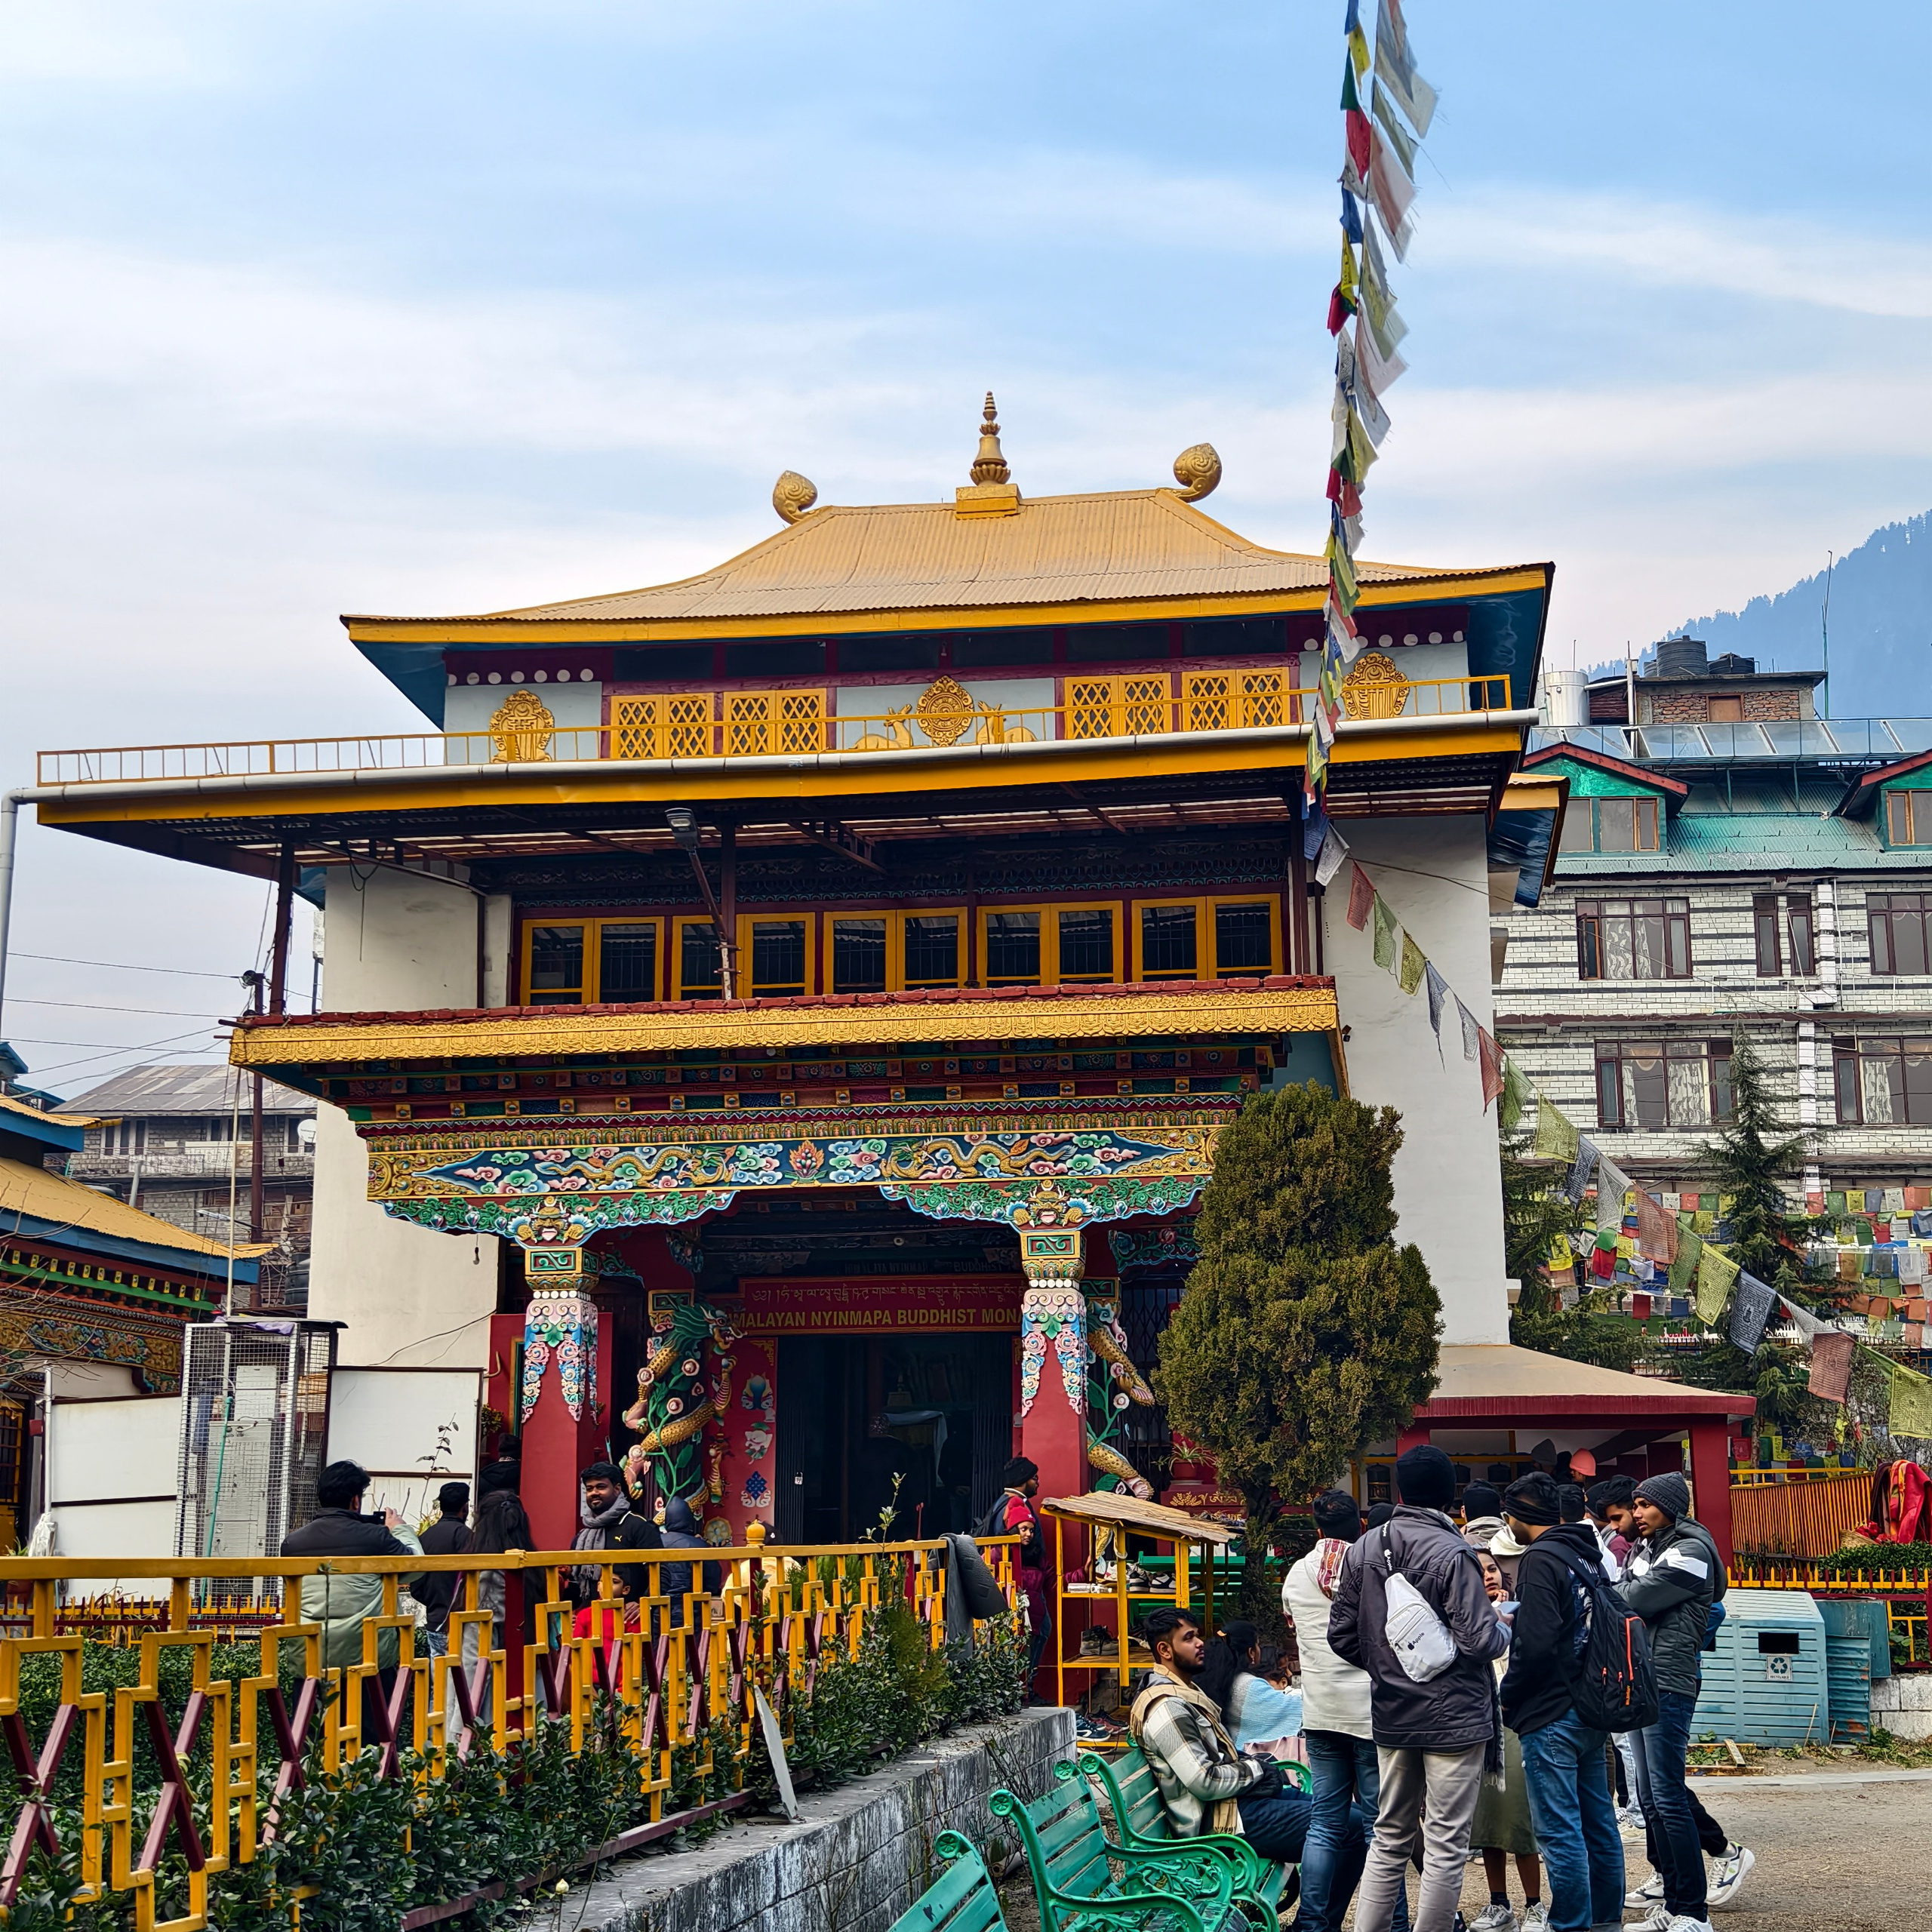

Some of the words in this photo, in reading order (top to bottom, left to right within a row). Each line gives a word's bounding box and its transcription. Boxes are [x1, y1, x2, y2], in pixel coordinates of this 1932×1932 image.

[728, 1311, 806, 1327] MALAYAN
[811, 1309, 891, 1326] NYINMAPA
[897, 1308, 976, 1324] BUDDHIST
[1412, 1632, 1425, 1645] Apple
